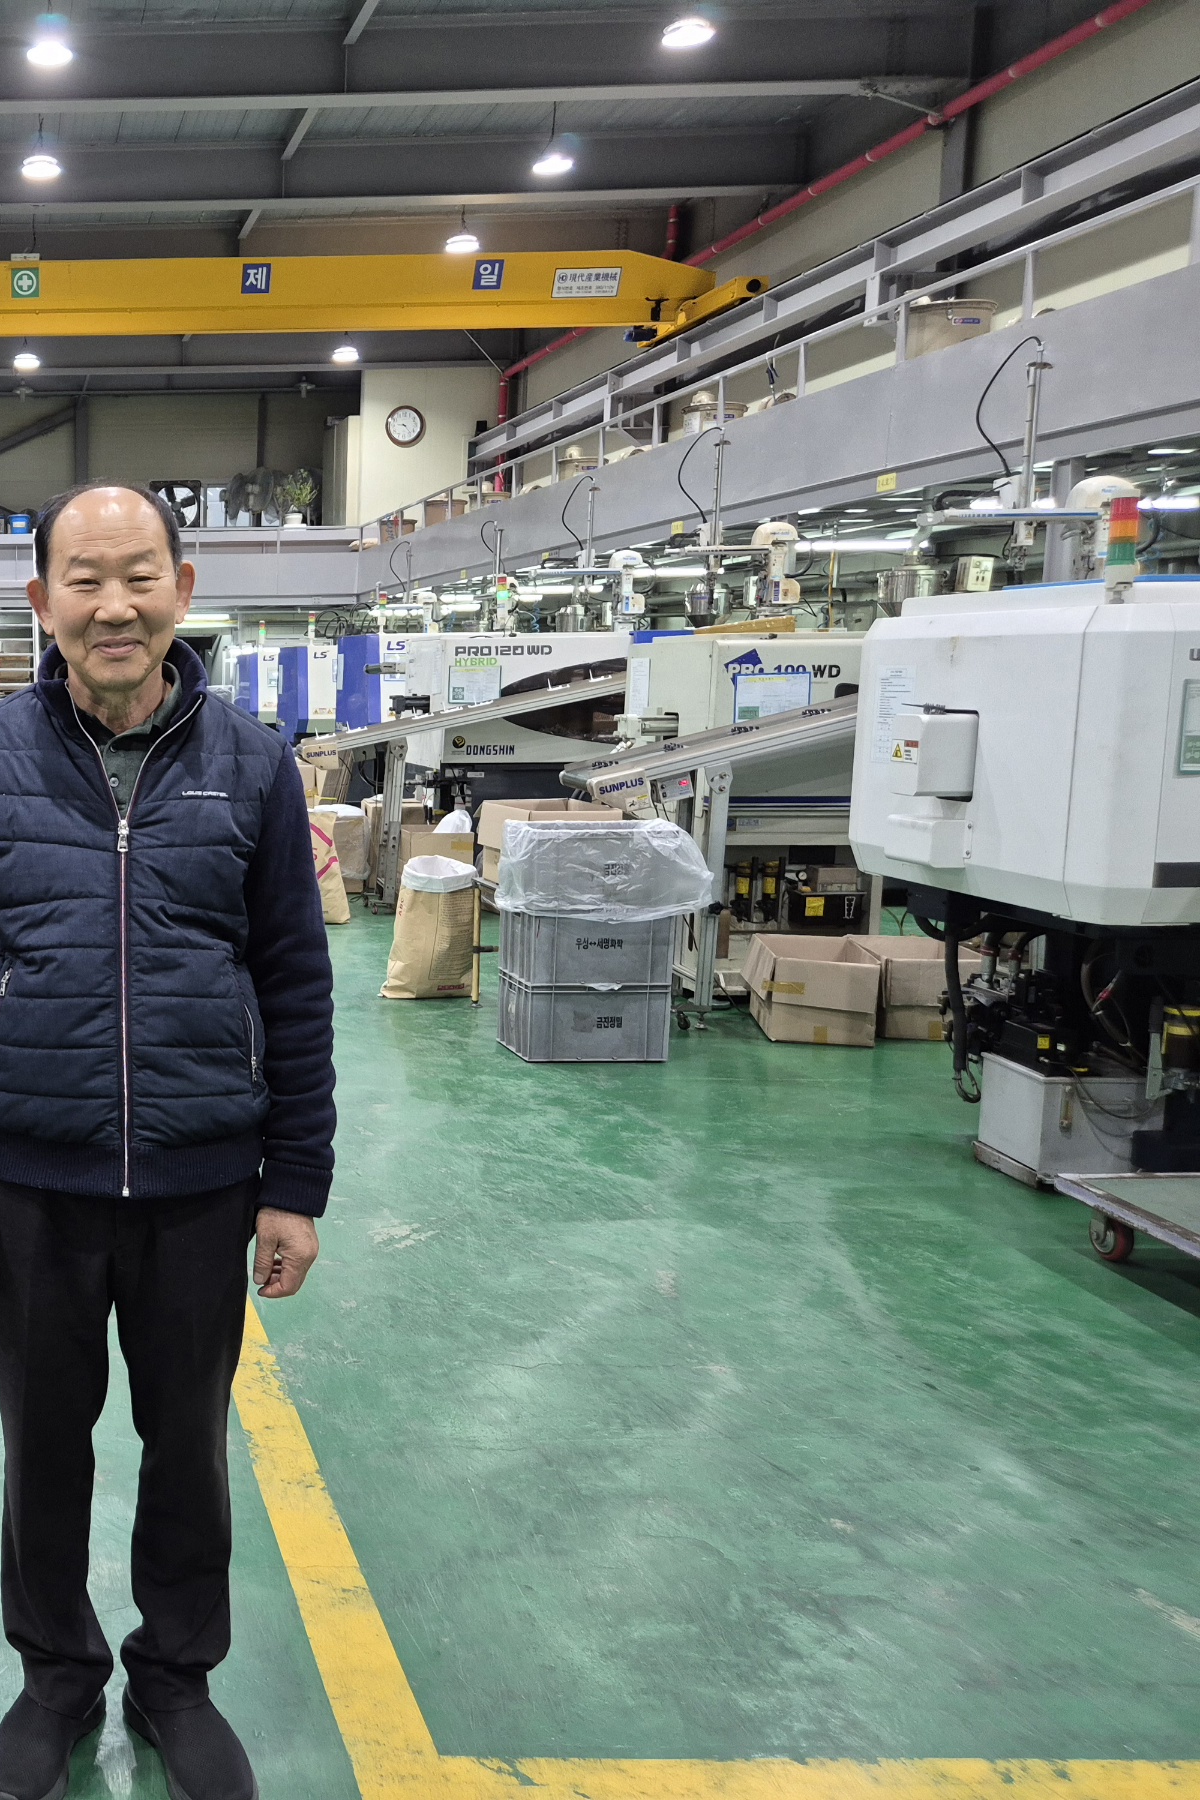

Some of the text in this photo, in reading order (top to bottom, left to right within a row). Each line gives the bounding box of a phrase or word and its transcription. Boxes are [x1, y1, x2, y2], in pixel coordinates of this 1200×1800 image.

[245, 266, 267, 290] 제
[479, 263, 499, 286] 일
[386, 640, 406, 651] LS
[455, 644, 553, 656] PRO 120 WD
[313, 651, 327, 659] LS
[455, 657, 498, 667] HYBRID
[811, 664, 841, 679] WD
[306, 749, 337, 759] SUNPLUS
[466, 744, 515, 756] DONGSHIN
[598, 777, 645, 796] SUNPLUS
[596, 1015, 623, 1029] 금진정밀
